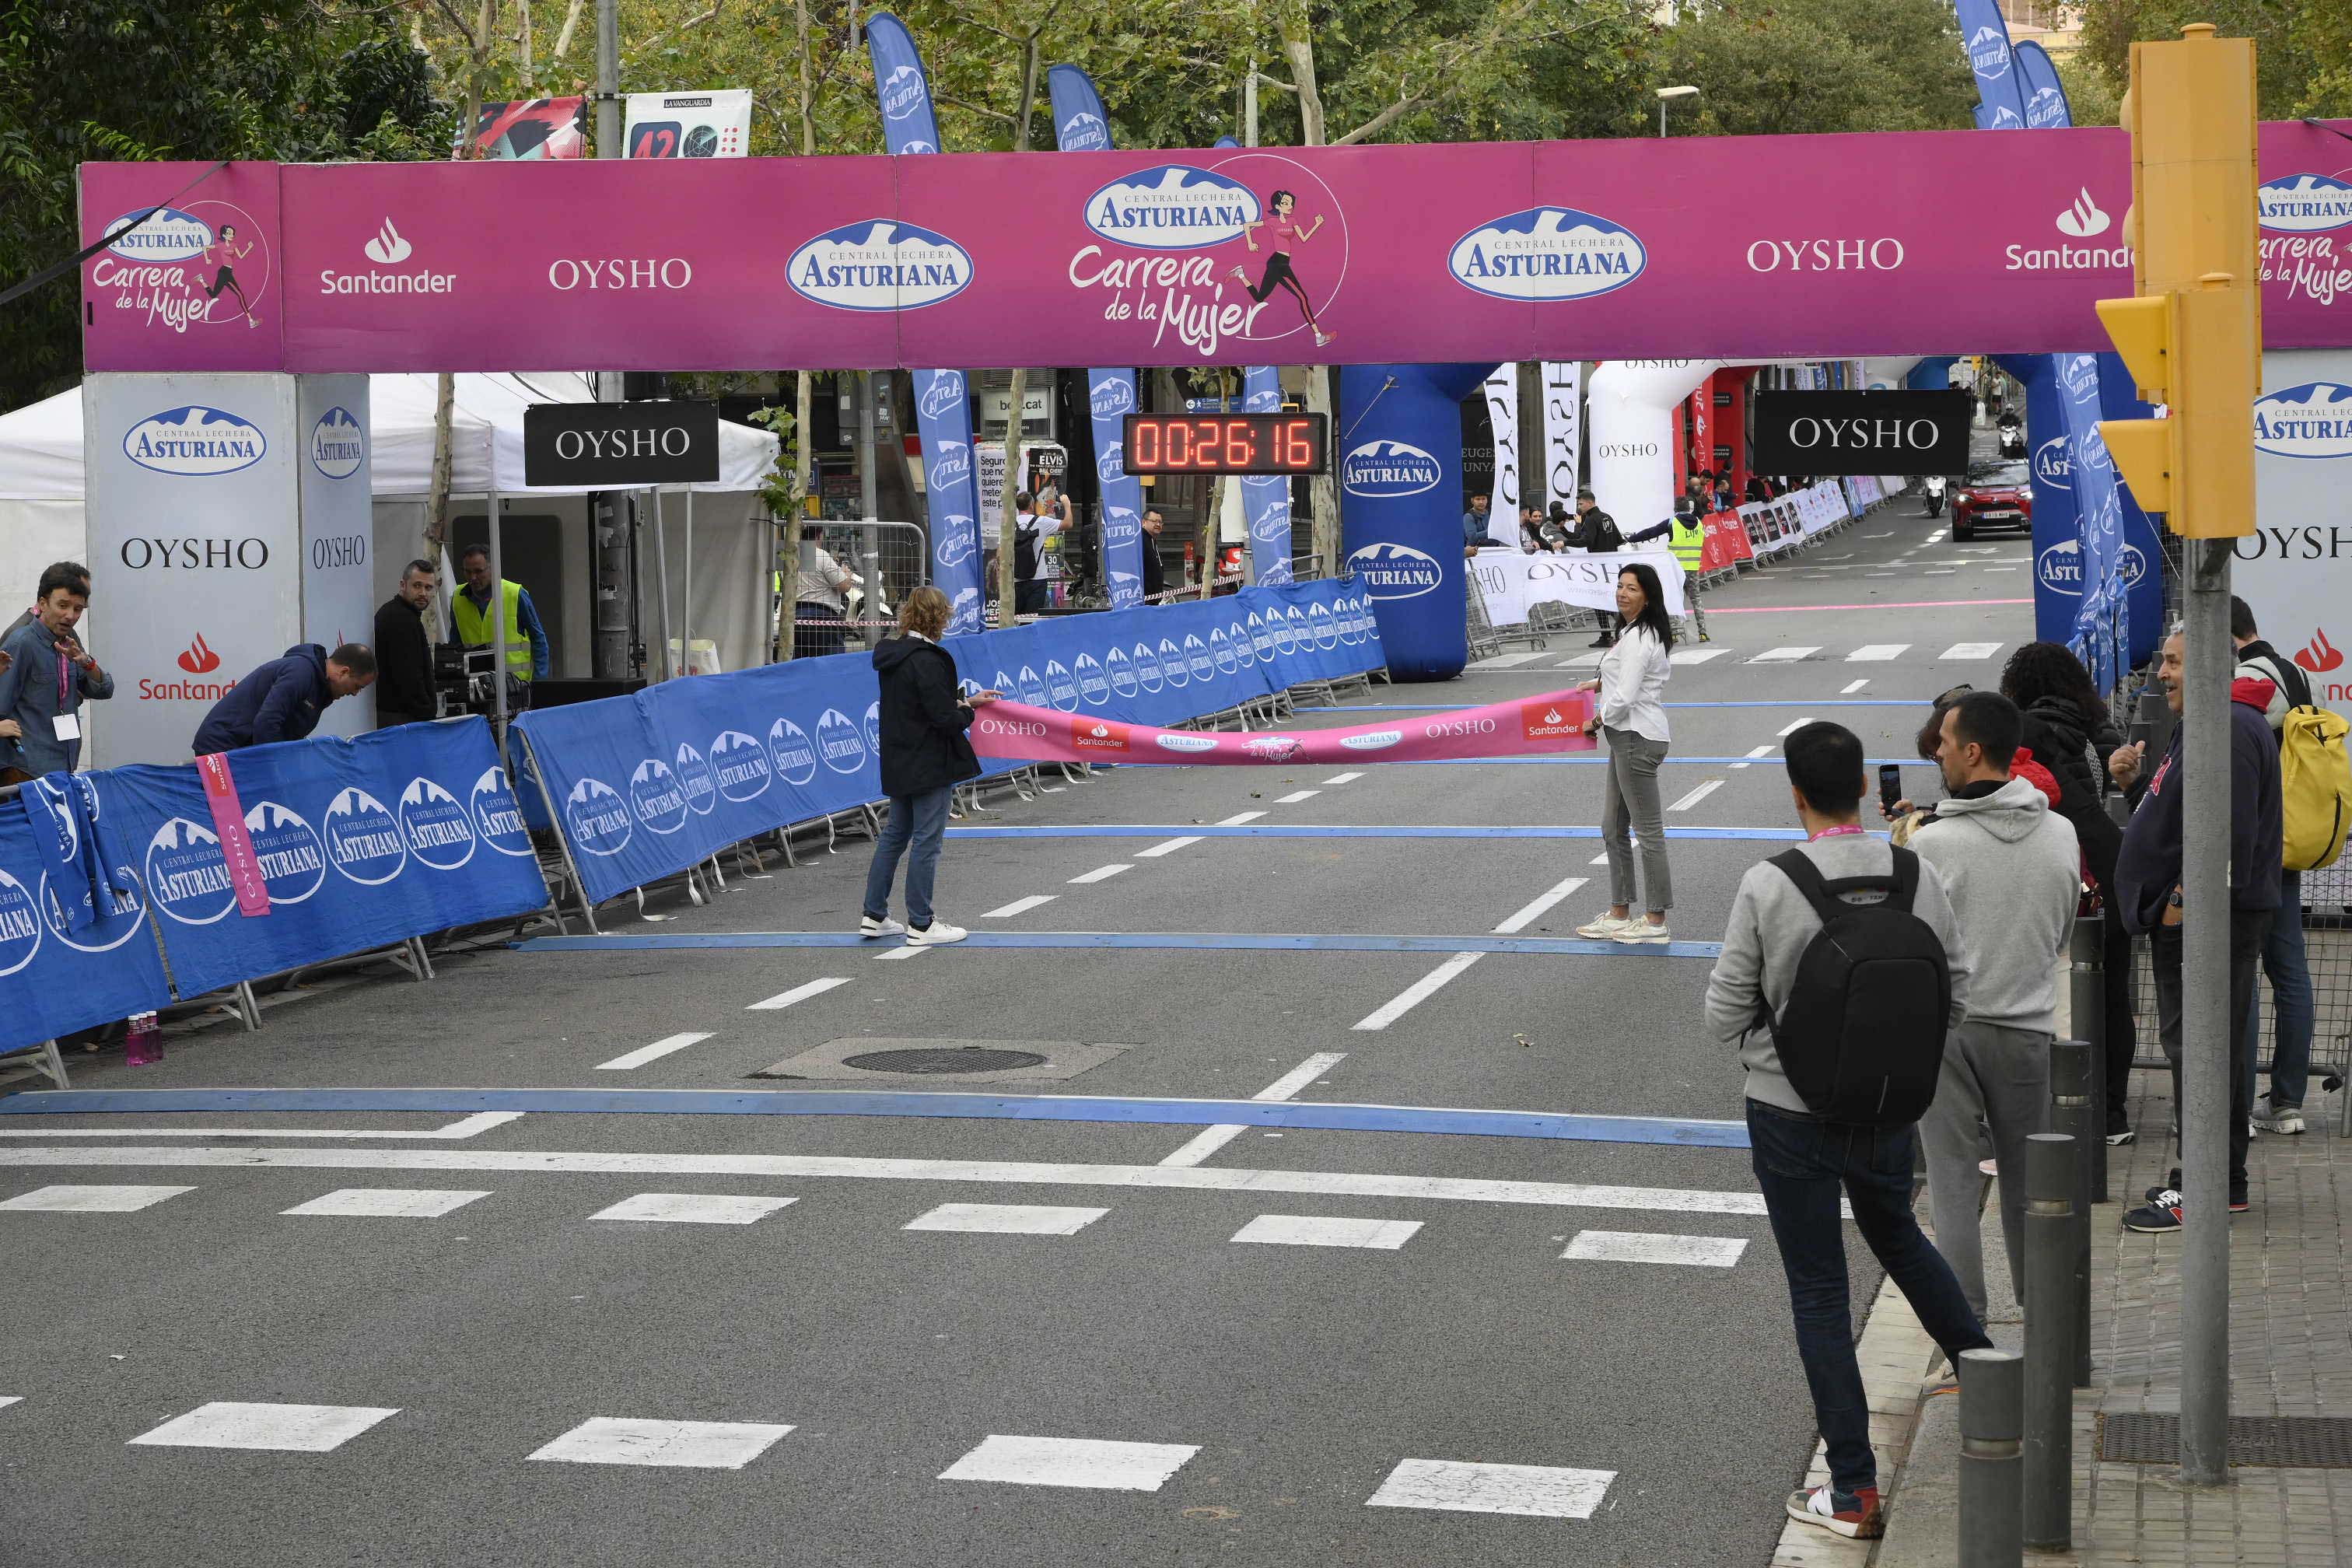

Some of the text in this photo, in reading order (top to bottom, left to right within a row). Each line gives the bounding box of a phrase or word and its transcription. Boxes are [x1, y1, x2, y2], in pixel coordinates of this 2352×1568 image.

[672, 99, 711, 107] VANGUARDIA
[1125, 191, 1242, 203] CENTRAL LECHERA
[1097, 196, 1246, 229] ASTURIANA
[111, 227, 205, 248] ASTURIANA
[1494, 237, 1625, 250] CENTRAL LECHERA
[2259, 236, 2333, 259] arrera
[829, 250, 953, 261] CENTRAL LECHERA
[1464, 243, 1632, 278] ASTURIANA
[1747, 238, 1905, 271] OYSHO
[2005, 244, 2135, 270] Santand
[93, 258, 184, 289] Carrera
[548, 258, 691, 290] OYSHO
[800, 254, 960, 288] ASTURIANA
[1069, 244, 1214, 289] Carrera
[2277, 259, 2291, 281] la
[320, 270, 456, 295] Santander
[116, 285, 219, 334] de la Mujer
[1104, 282, 1269, 356] de la Mujer
[999, 399, 1042, 411] b.cat
[2274, 408, 2328, 417] CENTRAL
[156, 429, 201, 438] CENTRAL
[555, 427, 691, 460] OYSHO
[1136, 422, 1310, 466] 00:26:16
[1789, 417, 1940, 450] OYSHO
[135, 431, 257, 459] ASTURIANA
[315, 438, 361, 461] ASTURIANA
[1461, 448, 1496, 458] EUGE
[1598, 443, 1658, 459] OYSHO
[1039, 455, 1063, 465] ELVIS
[981, 468, 993, 478] que
[982, 477, 1006, 489] quiere
[1346, 464, 1434, 485] ASTURIANA
[982, 498, 996, 507] este
[121, 537, 268, 569] OYSHO
[313, 534, 366, 569] OYSHO
[138, 678, 236, 700] Santand
[980, 719, 1047, 738] OYSHO
[1342, 733, 1398, 745] ASTURIANA
[1426, 718, 1496, 739] OYSHO
[1528, 723, 1579, 737] Santander
[821, 735, 863, 760] ASTURIANA
[1076, 736, 1124, 748] Santander
[1160, 735, 1215, 748] ASTURIANA
[412, 806, 459, 821] CENTRAL LECHERA
[485, 797, 511, 809] CENTRAL
[339, 817, 390, 833] CENTRAL LECHERA
[405, 814, 472, 850] ASTURIANA
[252, 831, 310, 851] CENTRAL LECHERA
[331, 826, 403, 864] ASTURIANA
[163, 848, 224, 869] CENTRAL LECHERA
[229, 824, 256, 898] OYSHO
[257, 844, 321, 882] STURIANA
[156, 862, 232, 904] ASTURIANA
